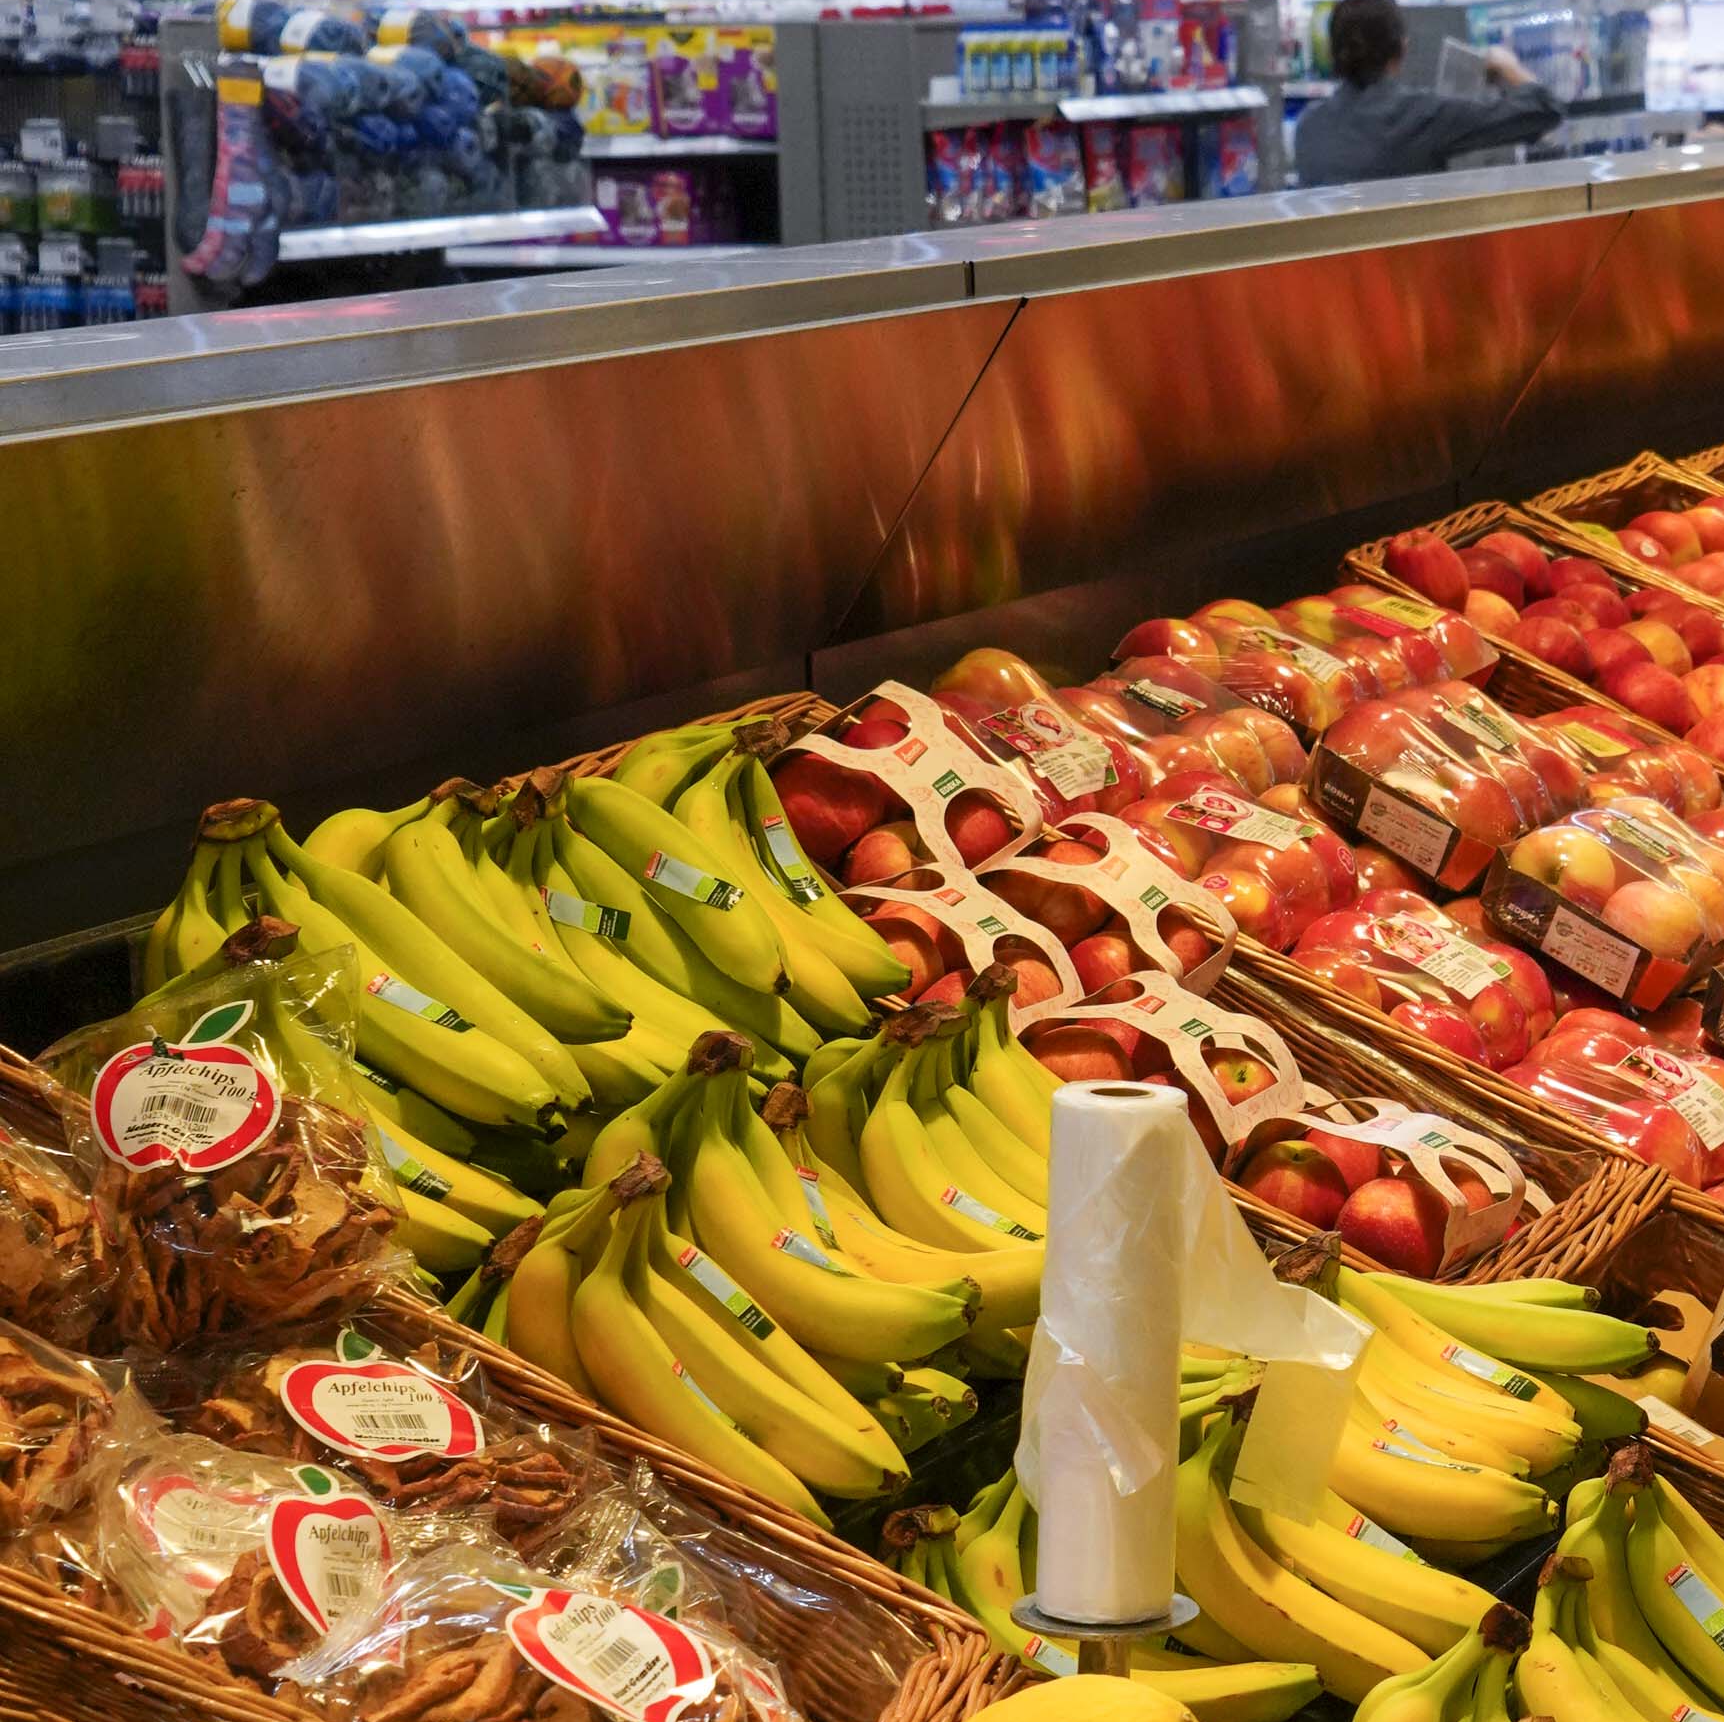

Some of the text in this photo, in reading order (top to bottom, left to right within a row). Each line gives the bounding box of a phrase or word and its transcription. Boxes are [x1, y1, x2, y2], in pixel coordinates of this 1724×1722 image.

[140, 1062, 239, 1086] Apfelchips
[218, 1086, 247, 1098] 100
[328, 1381, 417, 1397] Apfelchips
[409, 1393, 433, 1403] 100
[308, 1524, 370, 1544] Apfelchips
[593, 1603, 616, 1628] 100
